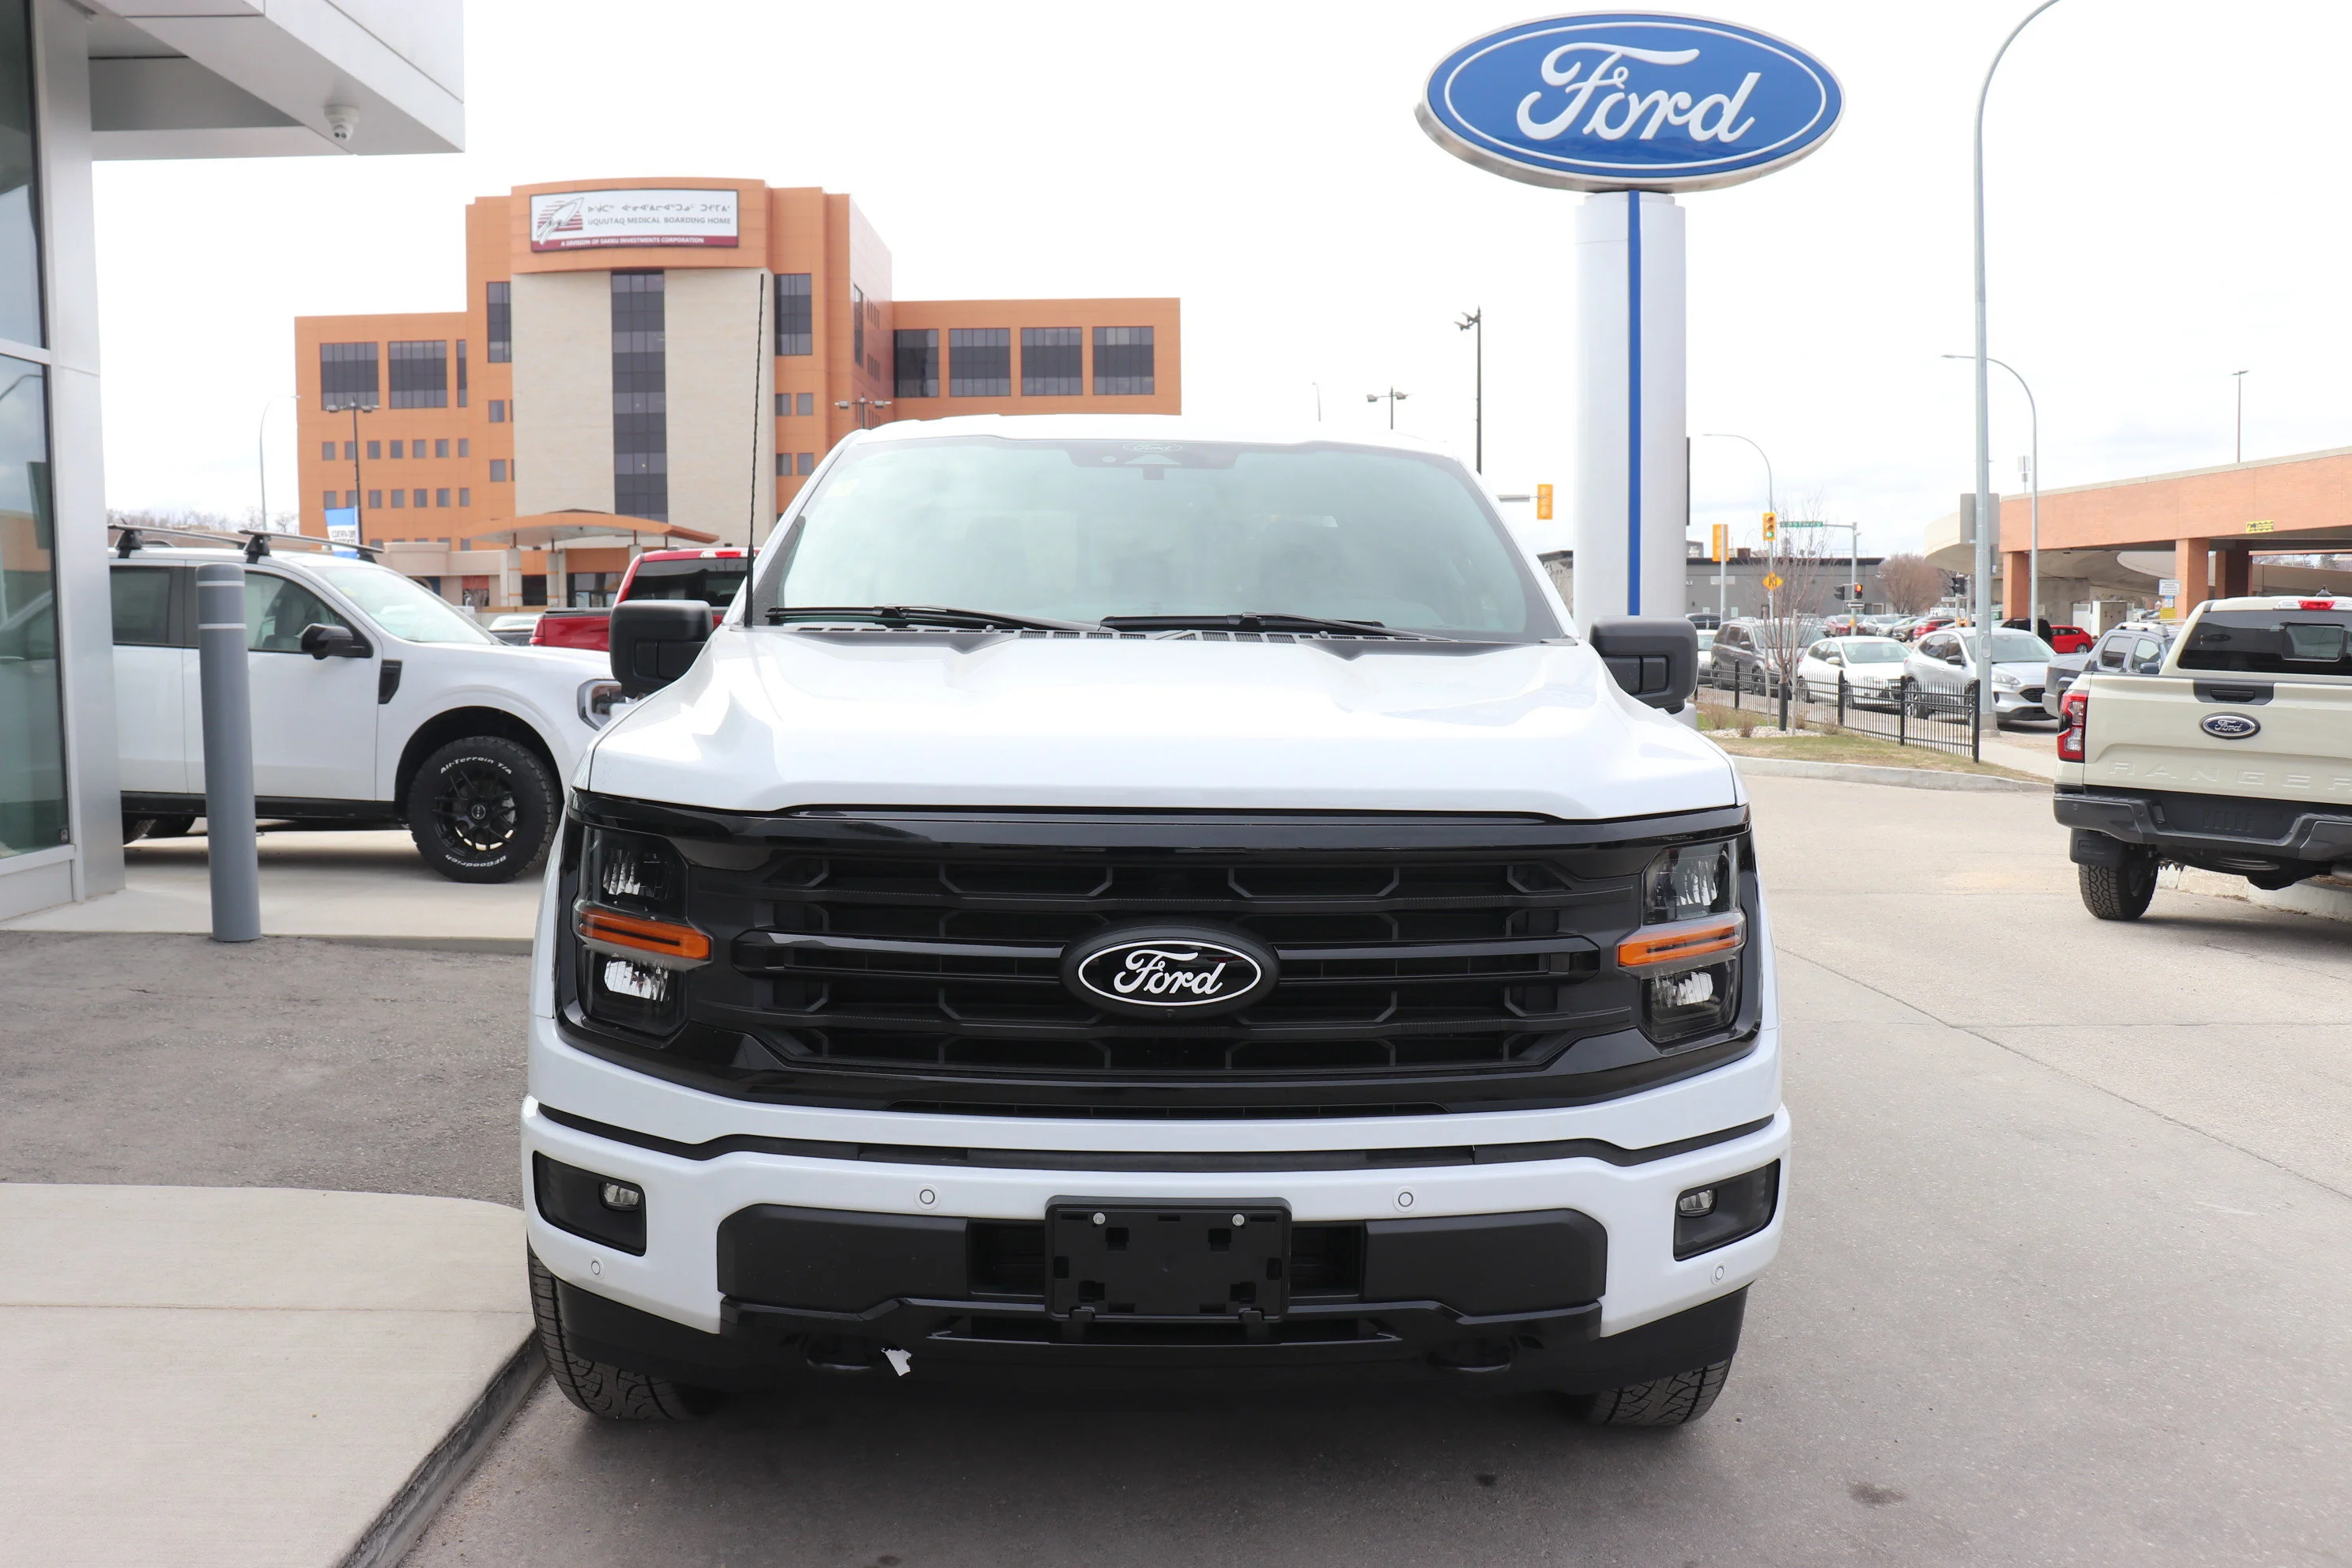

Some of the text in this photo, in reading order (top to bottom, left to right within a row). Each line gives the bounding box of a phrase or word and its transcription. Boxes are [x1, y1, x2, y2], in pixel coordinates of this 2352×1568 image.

[1516, 42, 1762, 143] Ford
[587, 217, 625, 226] UQUUTAQ
[627, 216, 661, 224] MEDICAL
[664, 216, 706, 224] BOARDING
[2214, 718, 2243, 733] Ford
[440, 756, 512, 775] All-Terrain T/A
[2109, 760, 2352, 792] RANGER
[445, 854, 507, 868] BFGoodrich
[1113, 949, 1227, 995] Ford
